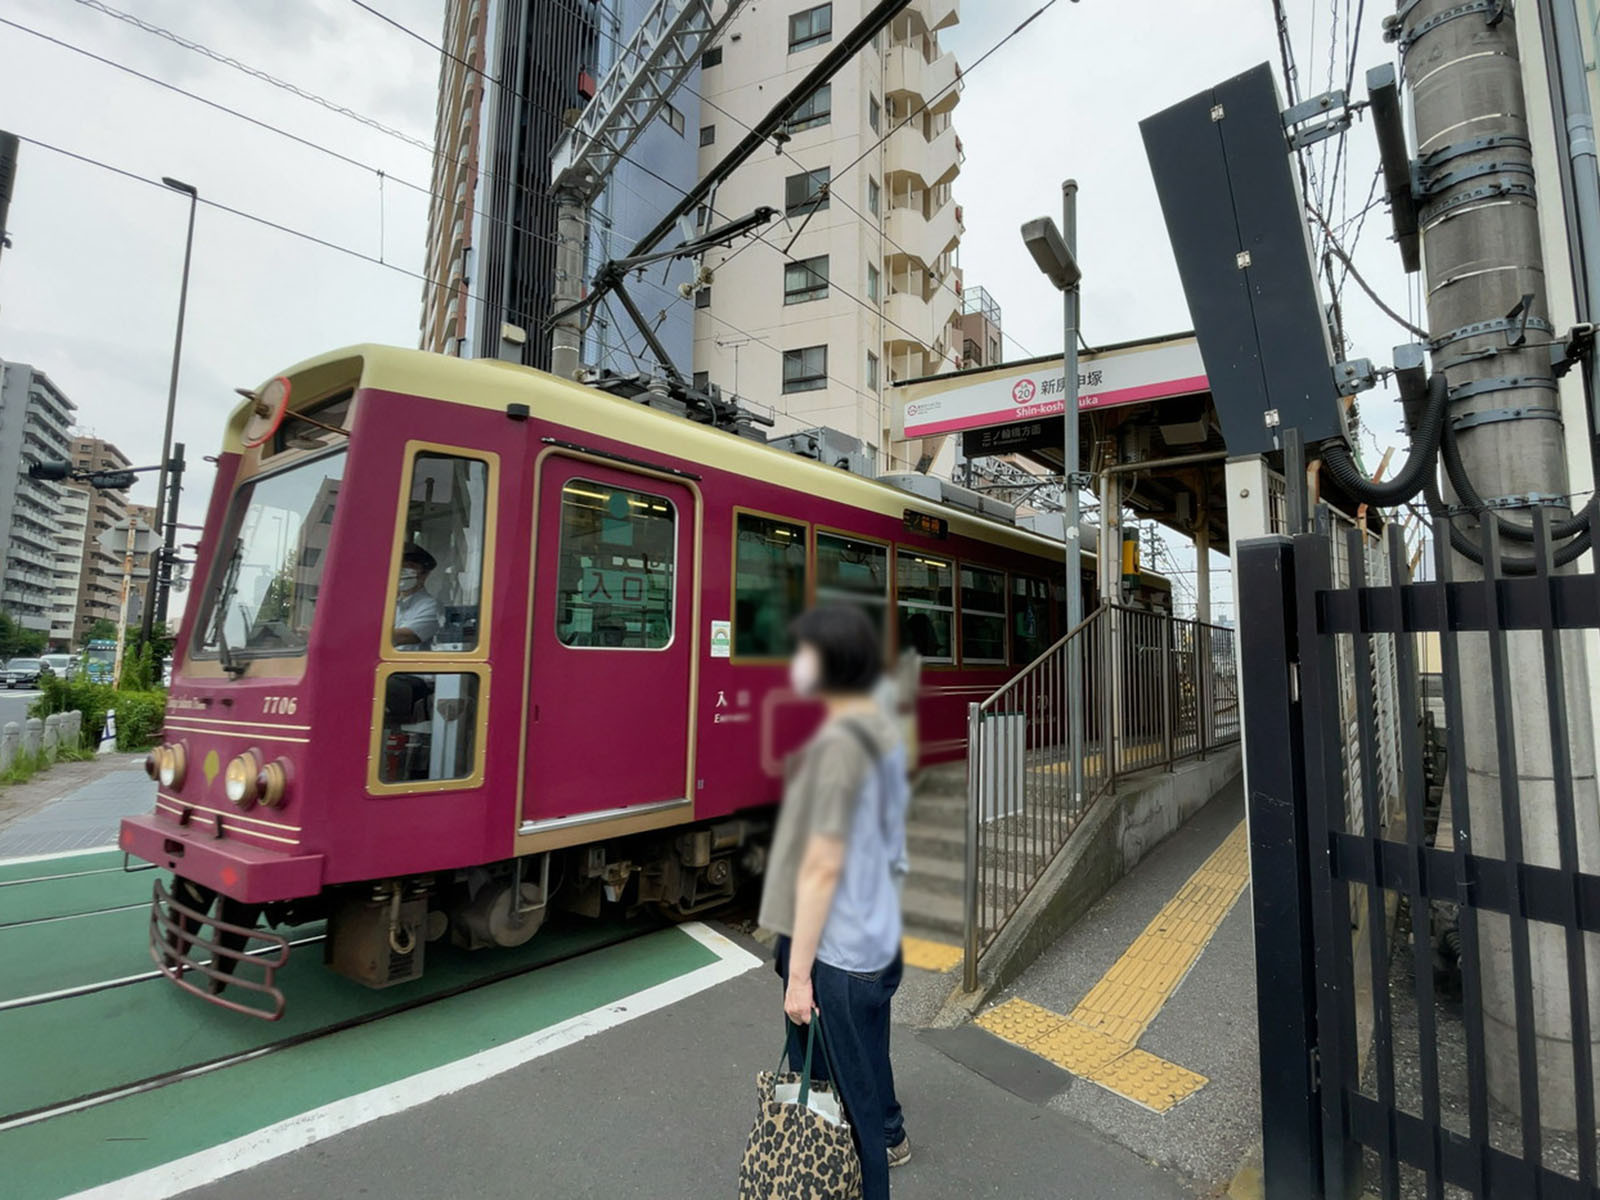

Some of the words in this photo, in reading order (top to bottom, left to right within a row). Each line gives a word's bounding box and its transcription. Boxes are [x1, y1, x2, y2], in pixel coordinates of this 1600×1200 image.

[1018, 388, 1030, 399] 20
[1016, 396, 1098, 417] Shin-koshuka
[588, 572, 643, 601] 入口
[263, 696, 299, 715] 7706
